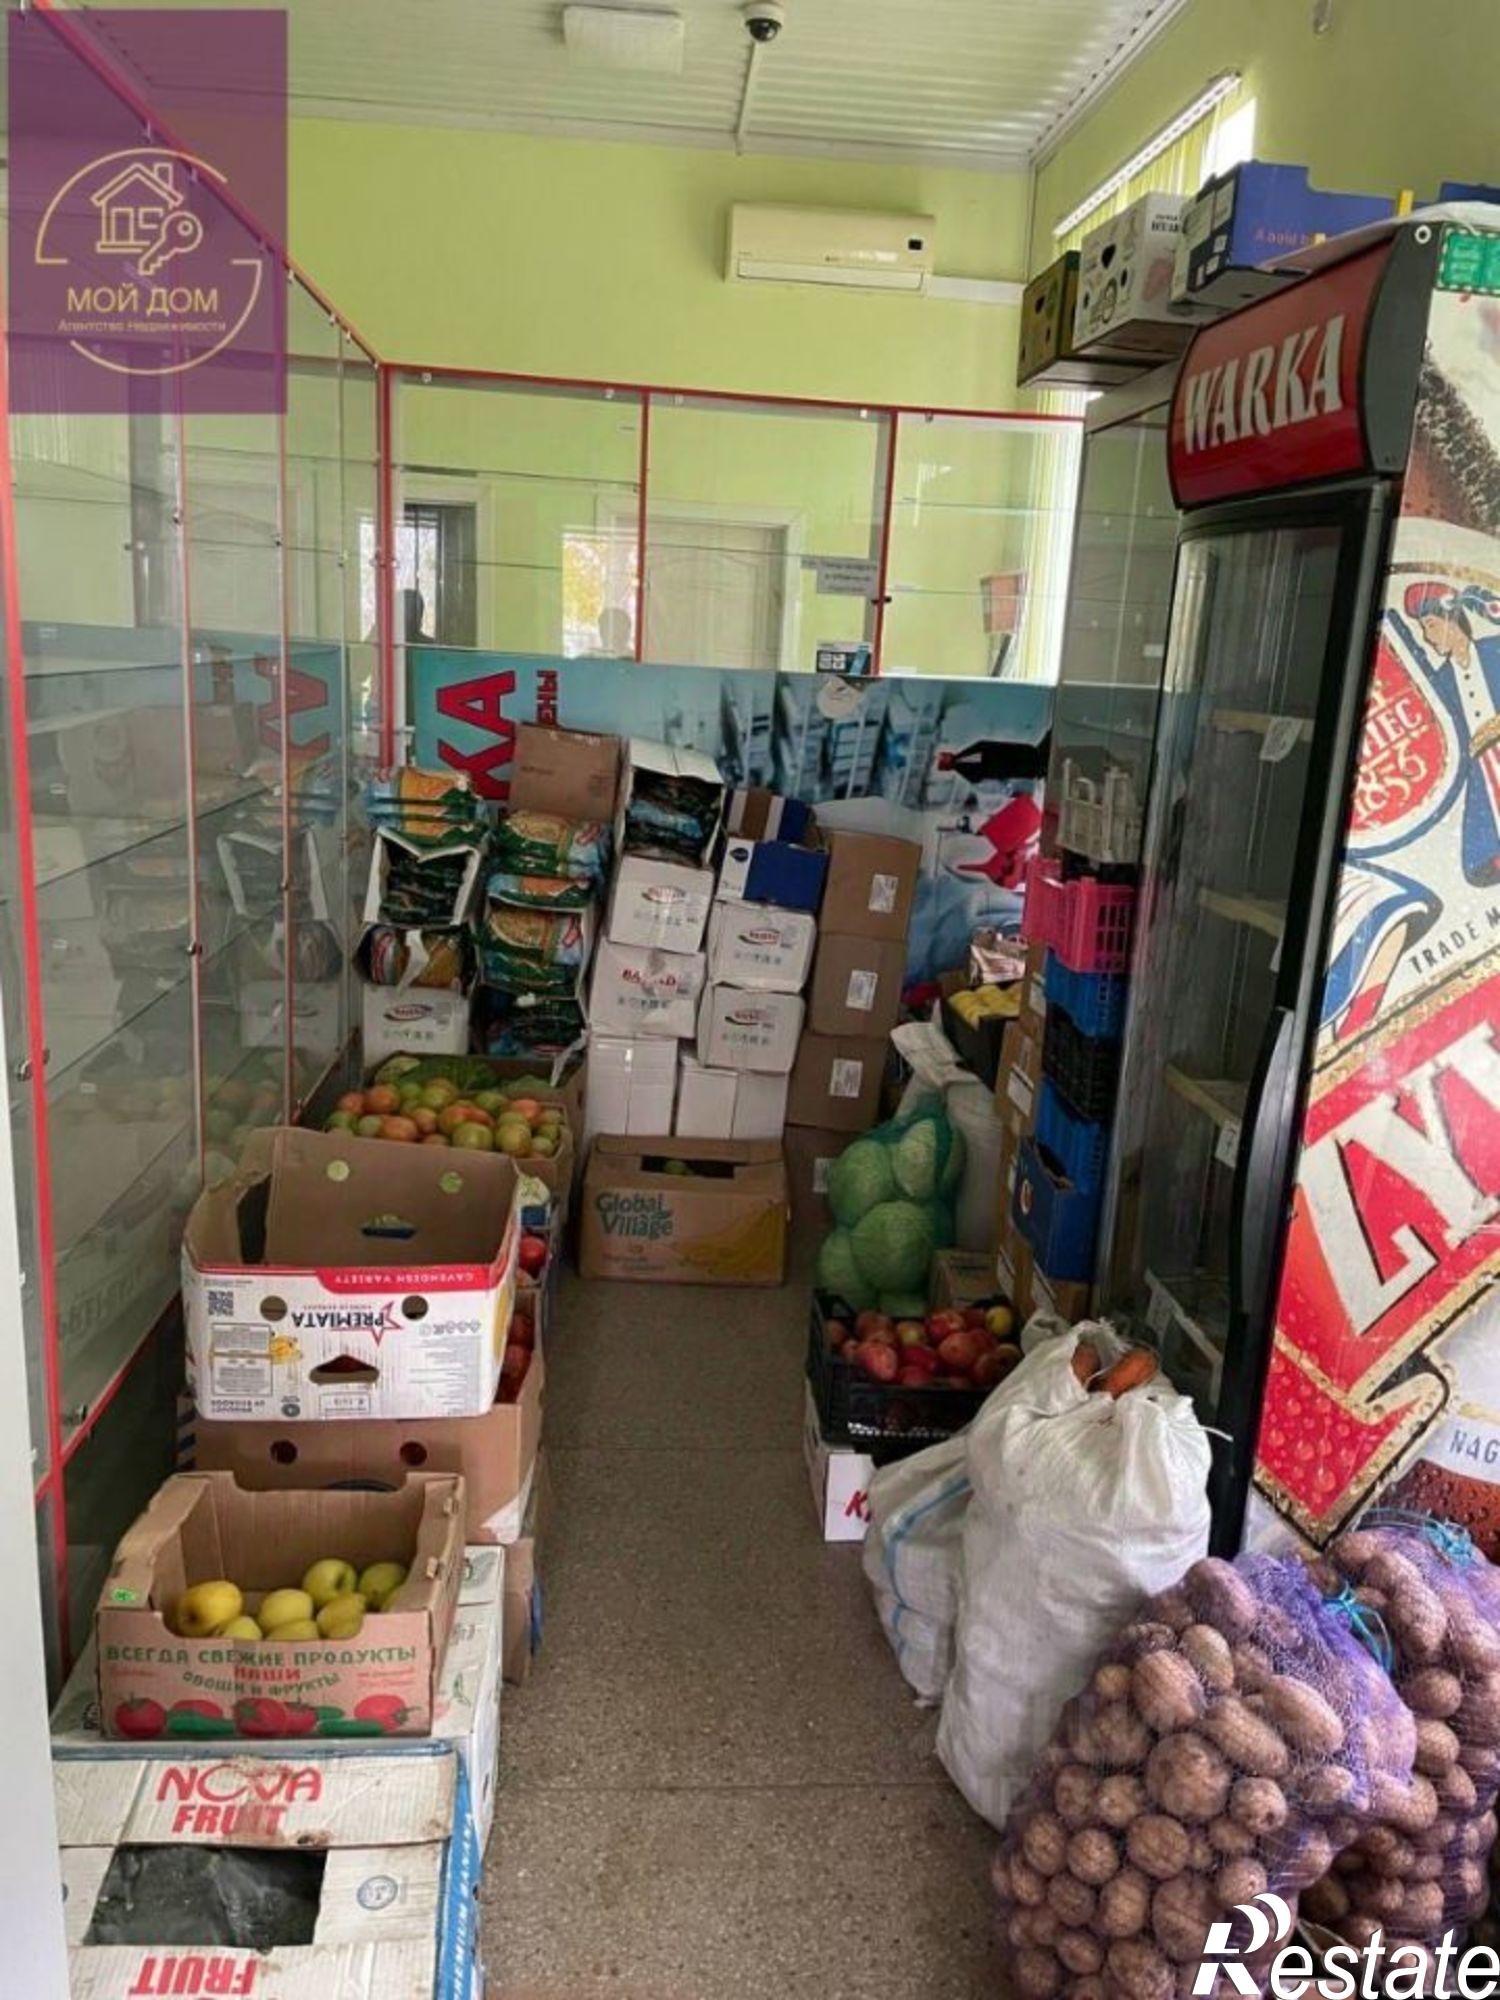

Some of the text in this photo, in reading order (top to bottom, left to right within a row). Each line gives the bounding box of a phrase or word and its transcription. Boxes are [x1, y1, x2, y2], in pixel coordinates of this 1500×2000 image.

[1183, 314, 1347, 455] WARKA
[1408, 922, 1481, 975] TRADE
[595, 1191, 664, 1214] Global
[600, 1212, 674, 1240] Village
[292, 1312, 385, 1329] PREMIATA
[105, 1646, 417, 1666] ВСЕГДА СВЕЖИЕ ПРОДУКТЫ
[268, 1672, 341, 1696] ФРУКТЫ
[156, 1763, 324, 1803] NOVA
[171, 1804, 287, 1836] FRUIT
[129, 1956, 256, 1994] FRUIT
